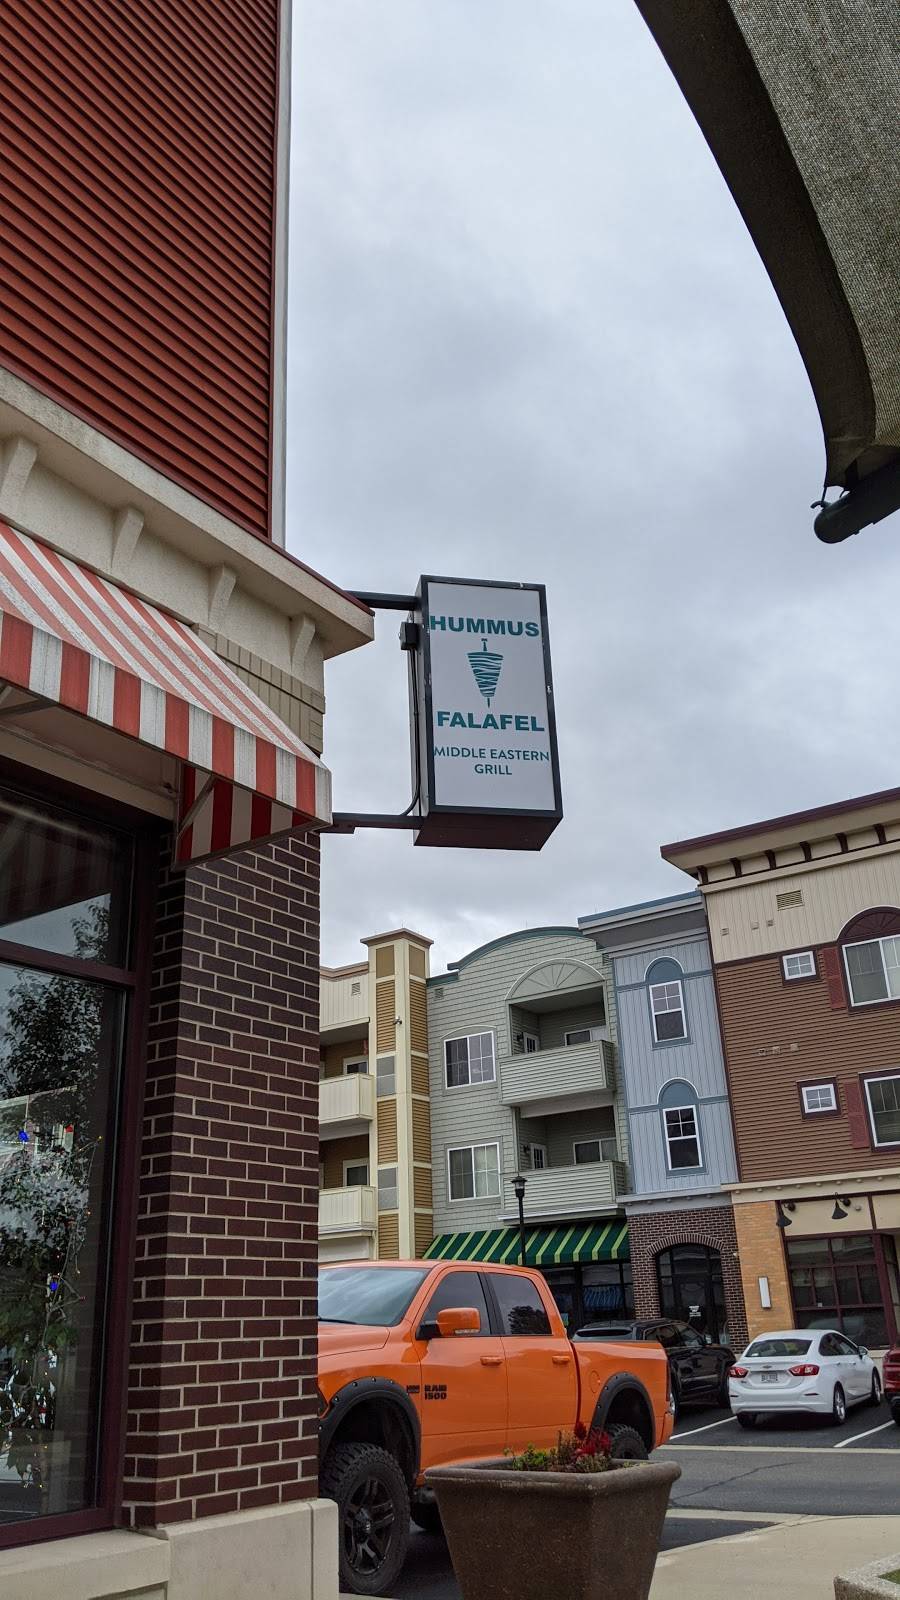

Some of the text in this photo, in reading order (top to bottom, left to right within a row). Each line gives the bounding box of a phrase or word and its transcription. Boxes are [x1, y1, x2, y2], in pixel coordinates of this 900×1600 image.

[430, 615, 540, 637] HUMMUS
[437, 711, 545, 732] FALAFEL
[434, 746, 550, 761] MIDDLE EASTERN
[474, 763, 513, 776] GRILL
[424, 1384, 448, 1392] RAM
[424, 1392, 448, 1400] 1500
